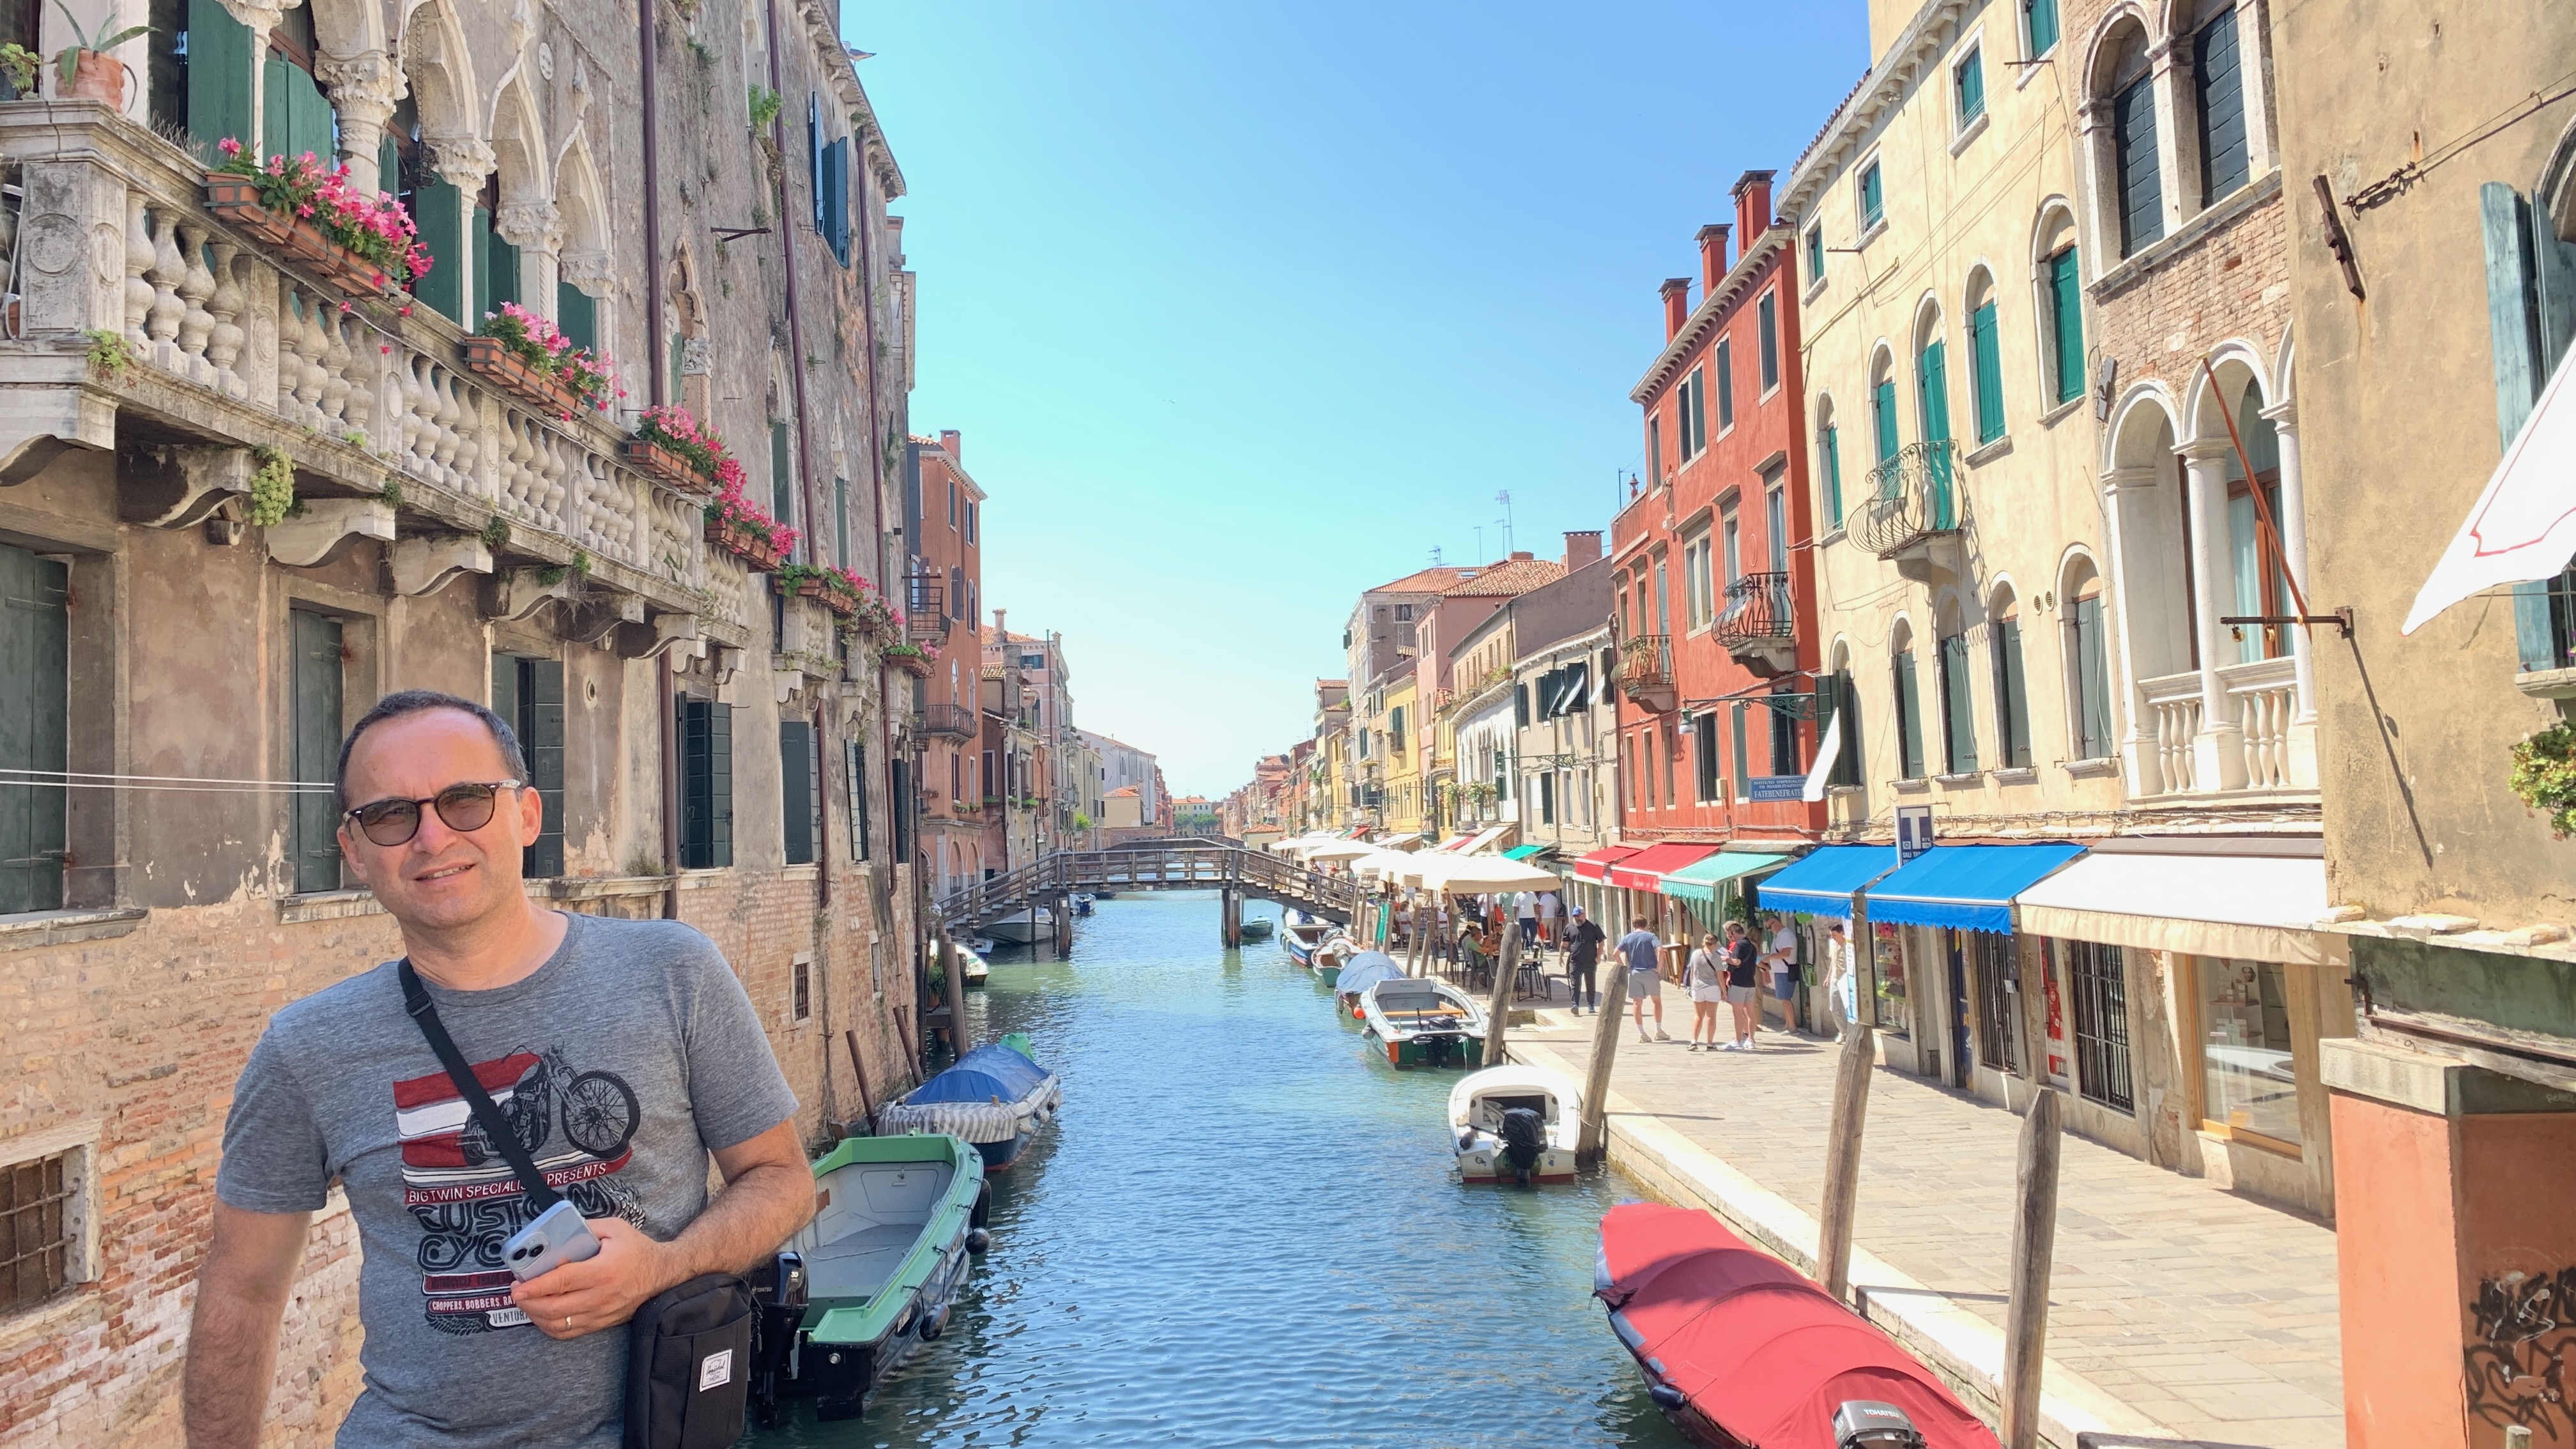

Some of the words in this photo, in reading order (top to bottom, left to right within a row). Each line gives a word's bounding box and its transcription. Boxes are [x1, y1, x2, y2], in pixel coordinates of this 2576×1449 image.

[1900, 808, 1929, 849] T
[466, 1179, 526, 1198] SPECIALI
[547, 1163, 606, 1186] PRESENTS
[432, 1300, 464, 1311] CHOPPERS,
[1863, 1409, 1900, 1418] TOHATSU
